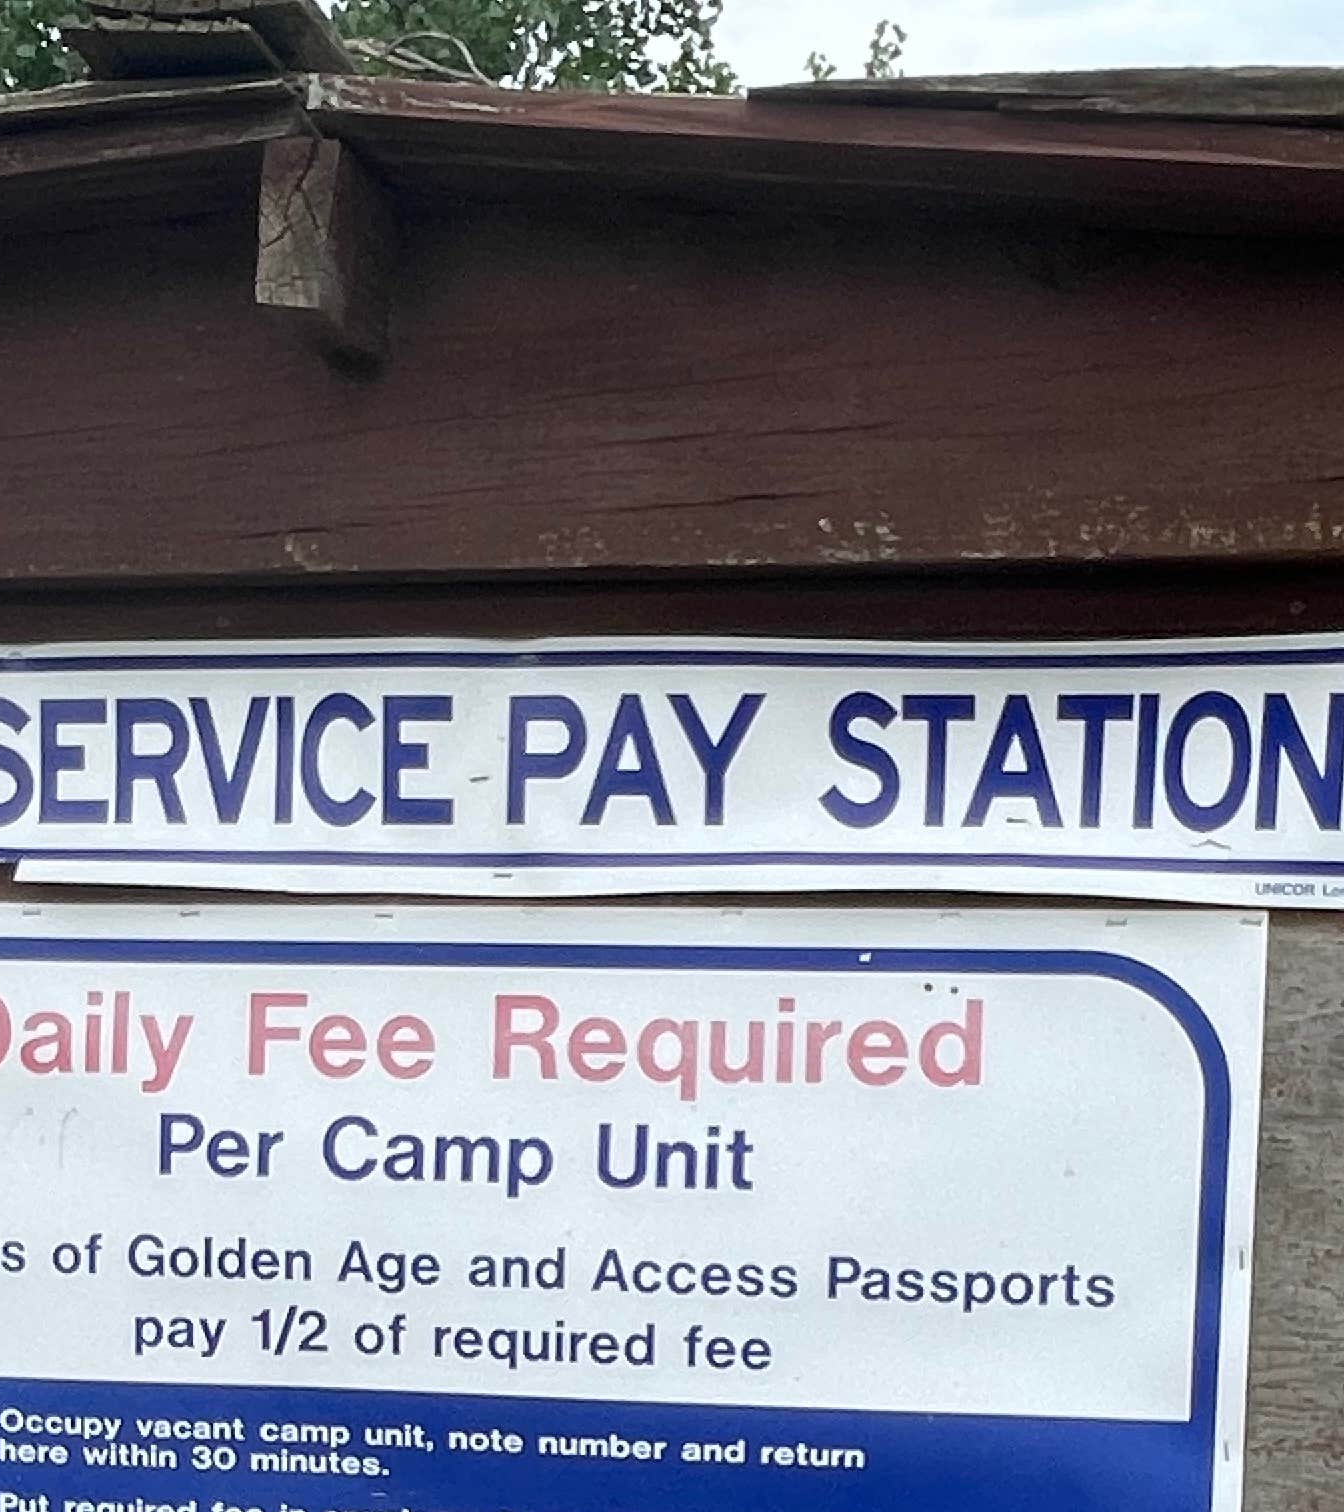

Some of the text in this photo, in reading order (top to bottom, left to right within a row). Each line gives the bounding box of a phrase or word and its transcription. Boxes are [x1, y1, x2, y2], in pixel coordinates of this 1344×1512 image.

[504, 692, 767, 826] PAY
[250, 992, 437, 1080] Fee
[493, 994, 985, 1101] Required
[157, 1113, 755, 1197] Per Camp Unit
[52, 1233, 103, 1275] of
[126, 1234, 312, 1281] Golden
[338, 1240, 441, 1293] Age
[467, 1247, 566, 1290] and
[592, 1248, 799, 1298] Access
[827, 1256, 1116, 1313] Passports
[133, 1306, 773, 1371] pay 1/2 of required fee
[83, 1444, 178, 1470] within
[192, 1446, 238, 1471] 30
[250, 1448, 390, 1477] minutes.
[136, 1418, 246, 1442] vacant
[260, 1421, 350, 1447] camp
[365, 1425, 435, 1452] unit,
[448, 1428, 524, 1454] note
[539, 1435, 667, 1462] number
[680, 1440, 747, 1464] and
[760, 1443, 866, 1470] return
